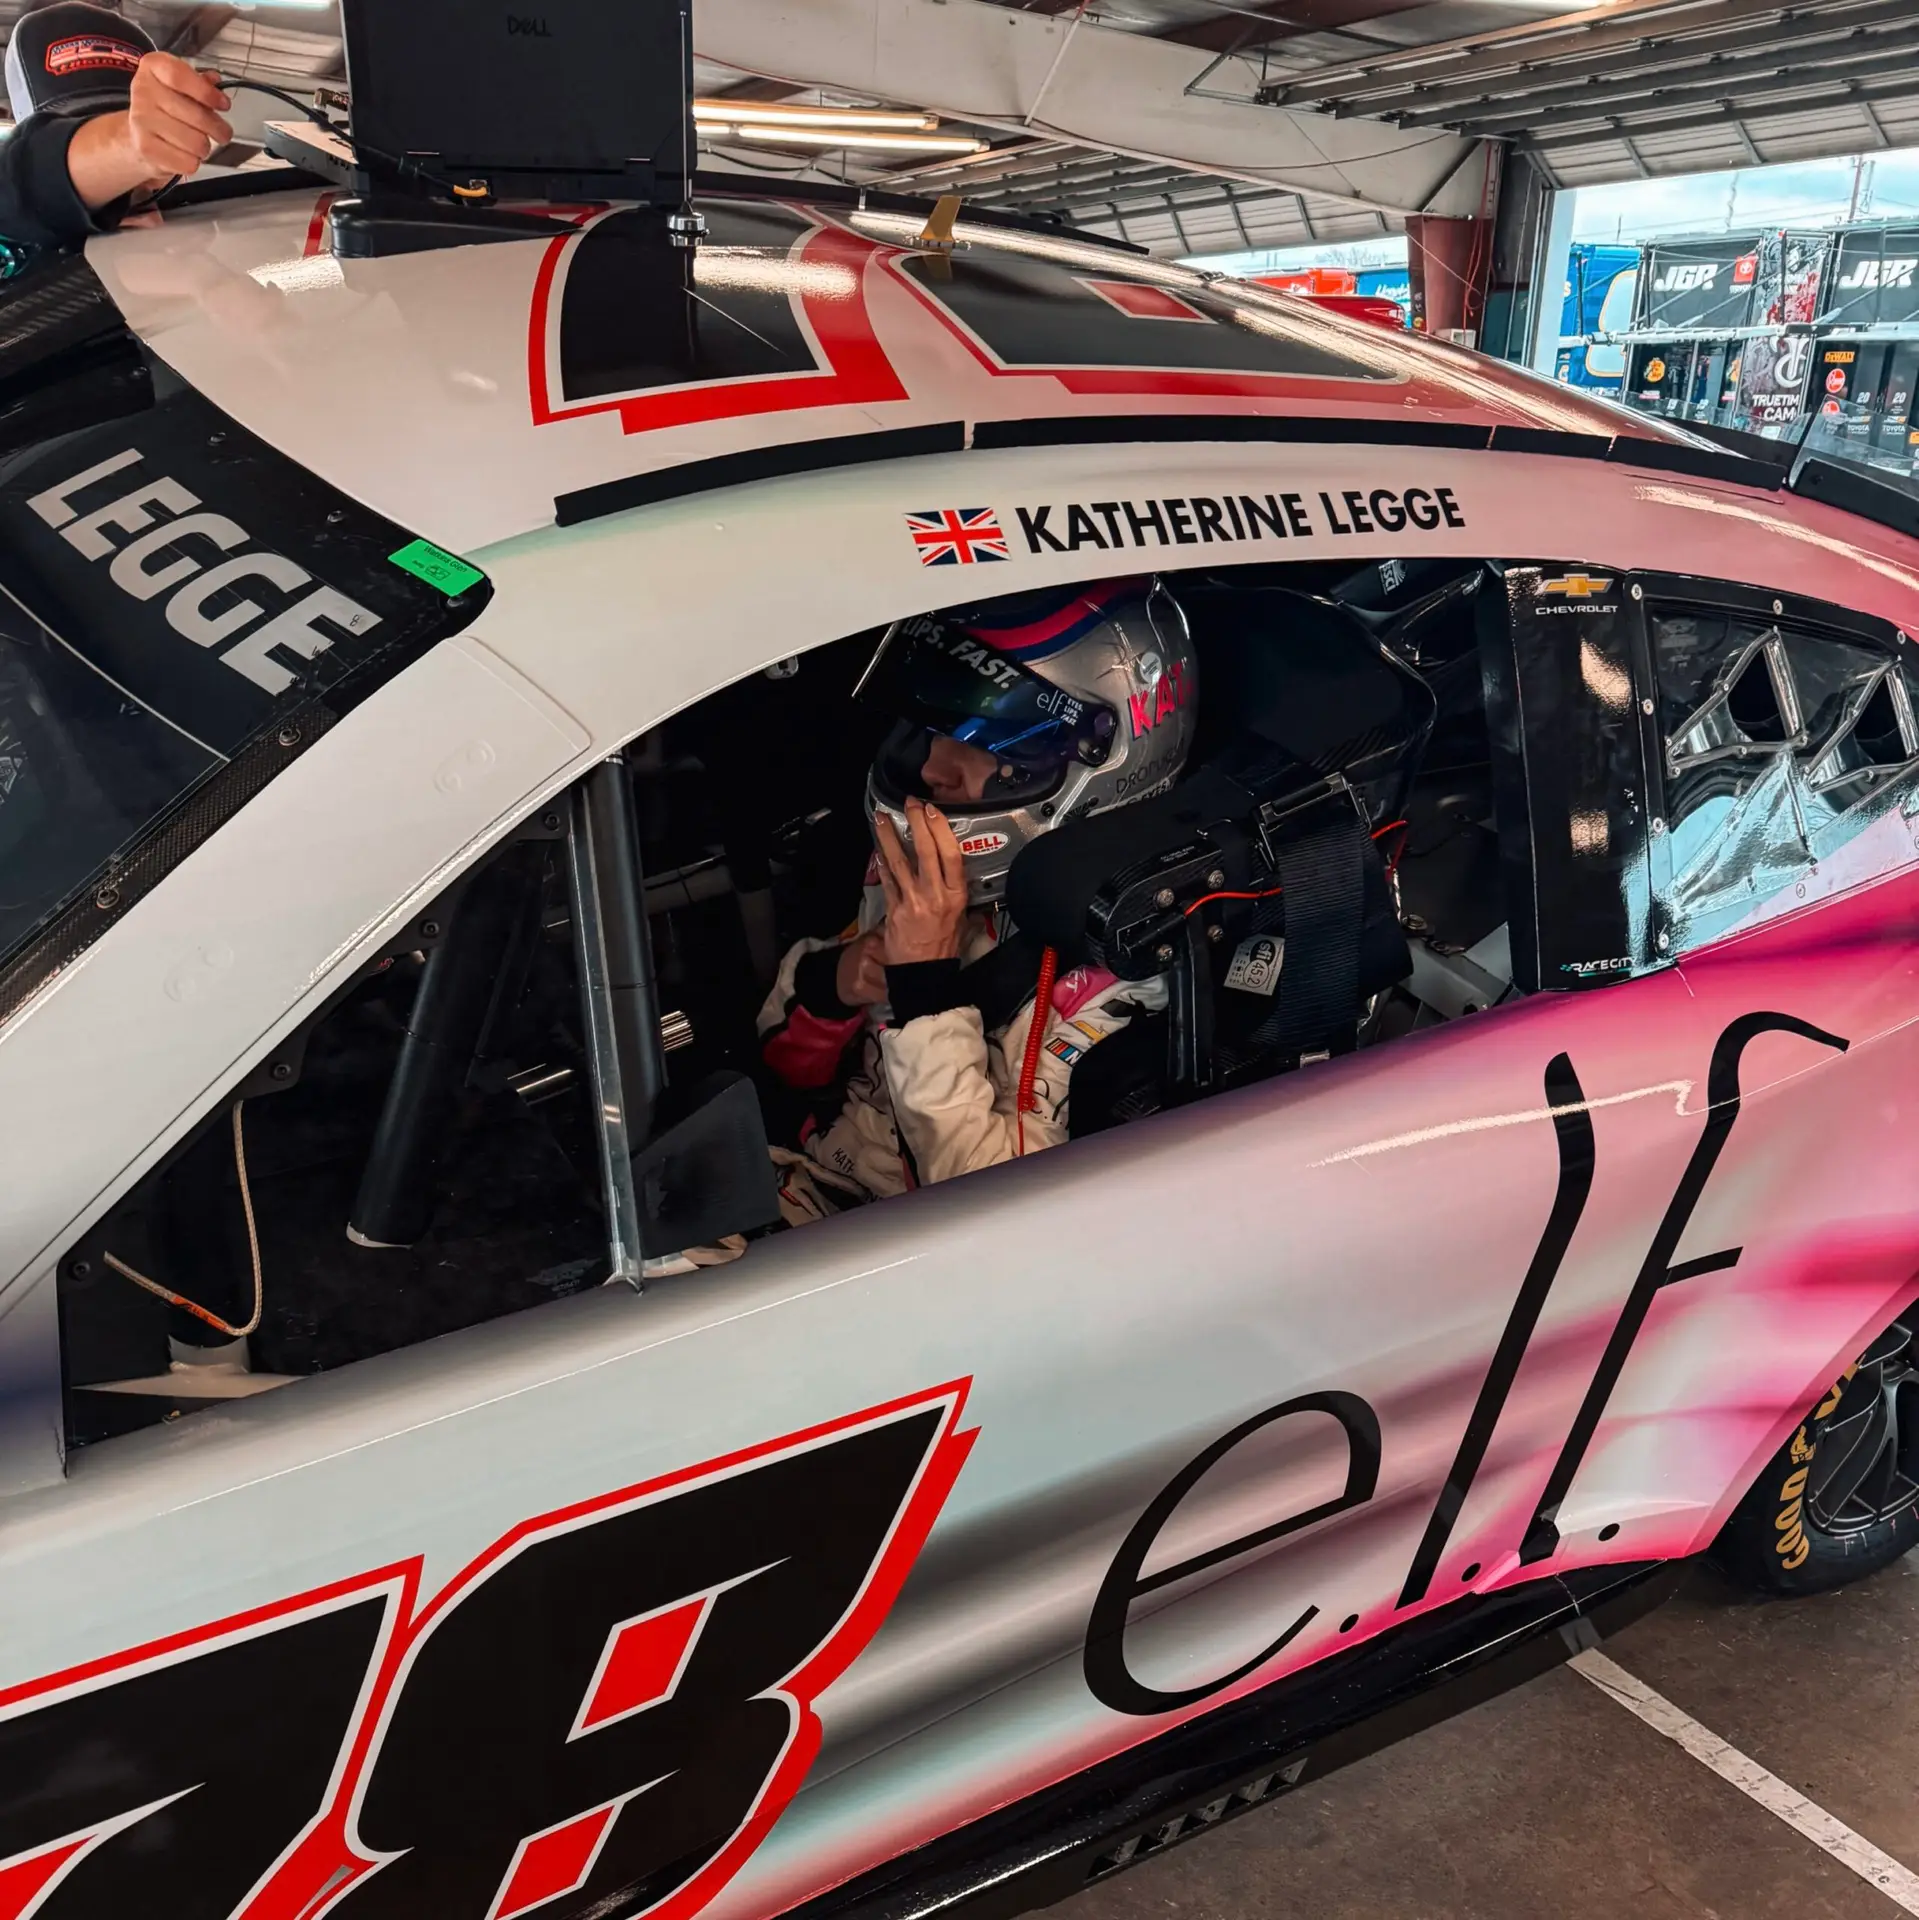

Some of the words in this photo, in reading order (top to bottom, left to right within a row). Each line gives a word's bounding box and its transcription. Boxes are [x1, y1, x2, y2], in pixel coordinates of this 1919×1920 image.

[507, 14, 553, 38] DELL
[1653, 264, 1718, 292] JGR
[1839, 259, 1919, 290] JGR
[1856, 391, 1871, 404] 20
[1892, 391, 1907, 404] 20
[1015, 493, 1313, 553] KATHERINE
[1318, 487, 1467, 535] LEGGE
[26, 447, 384, 697] LEGGE
[1535, 604, 1619, 616] CHEVROLET
[949, 639, 1021, 689] FAST.
[962, 835, 1005, 852] BELL
[1256, 942, 1273, 961] sfi
[1246, 962, 1266, 985] 45.2
[1083, 1010, 1851, 1716] e.l.f.
